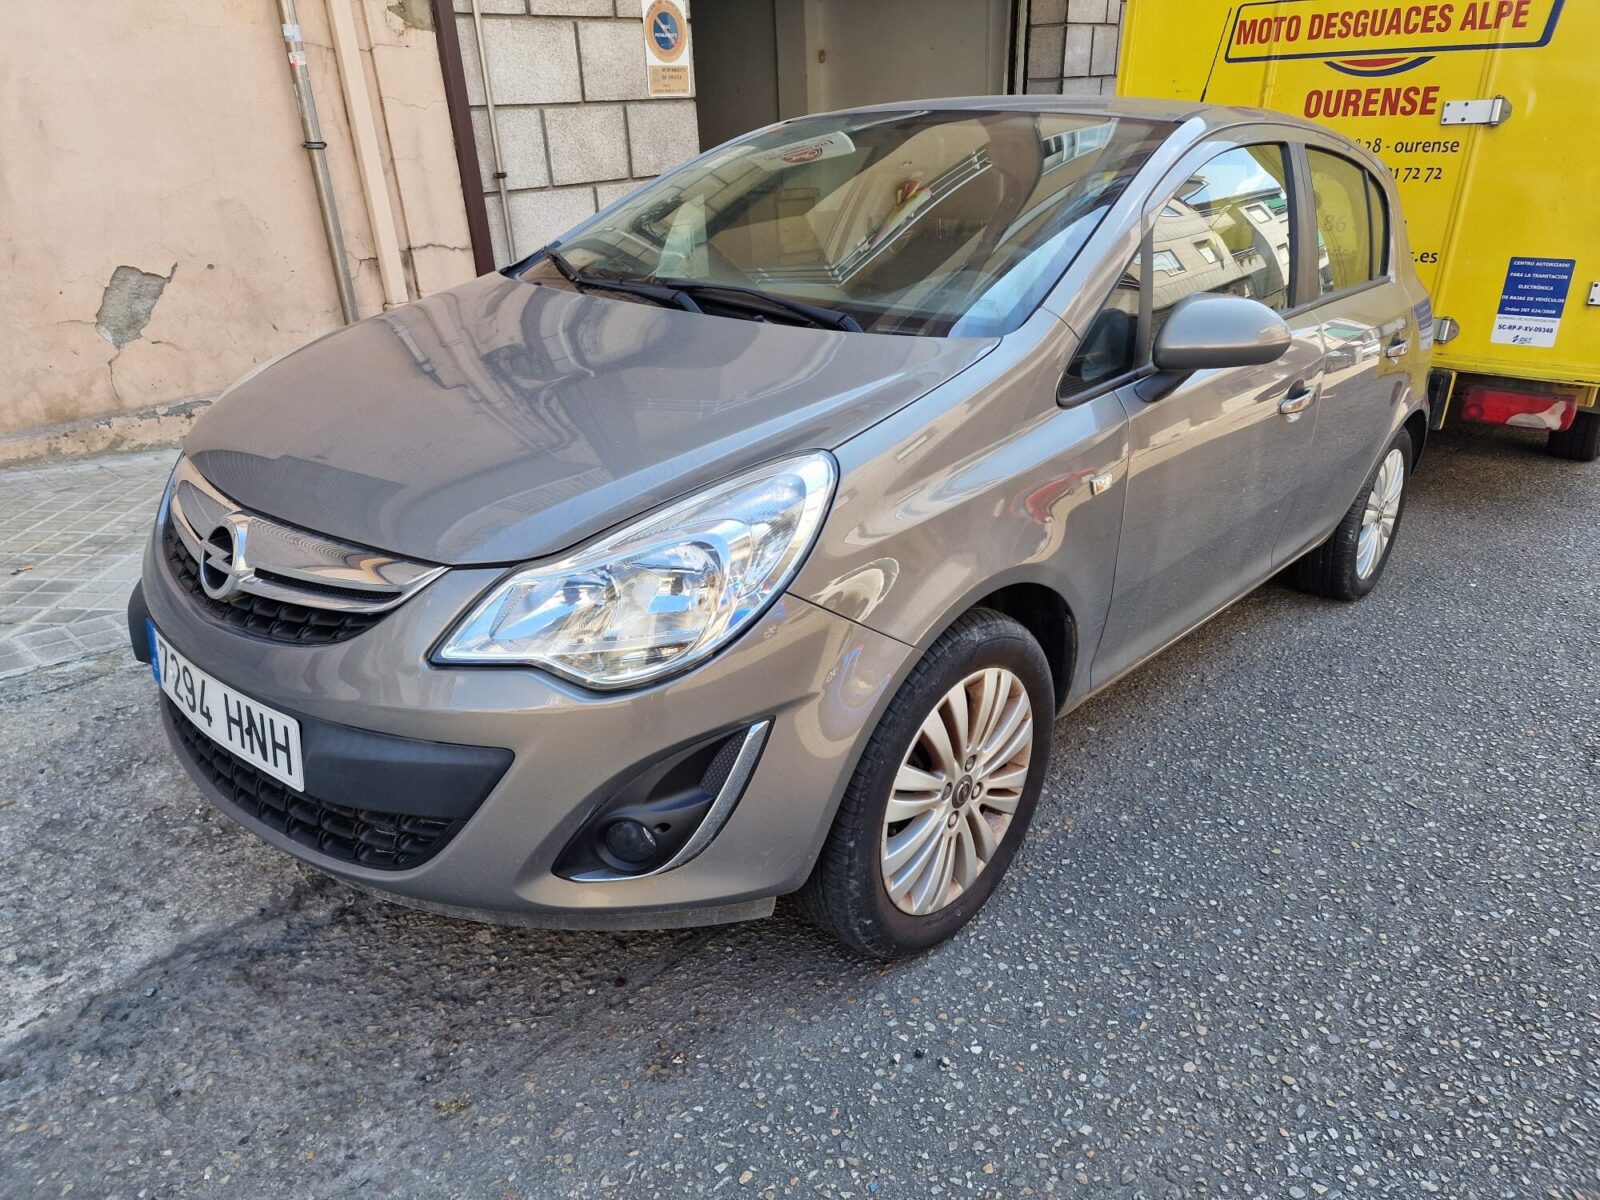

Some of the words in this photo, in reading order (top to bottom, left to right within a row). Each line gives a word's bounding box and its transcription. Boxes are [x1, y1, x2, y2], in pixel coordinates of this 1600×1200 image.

[1235, 16, 1301, 45] MOTO
[1307, 4, 1454, 41] DESGUACES
[1459, 0, 1532, 31] ALPE
[1303, 86, 1440, 118] OURENSE
[1394, 140, 1460, 153] ourense
[1402, 168, 1420, 183] 72
[1424, 168, 1442, 183] 72
[158, 638, 213, 728] 7294
[223, 692, 293, 776] HNH
